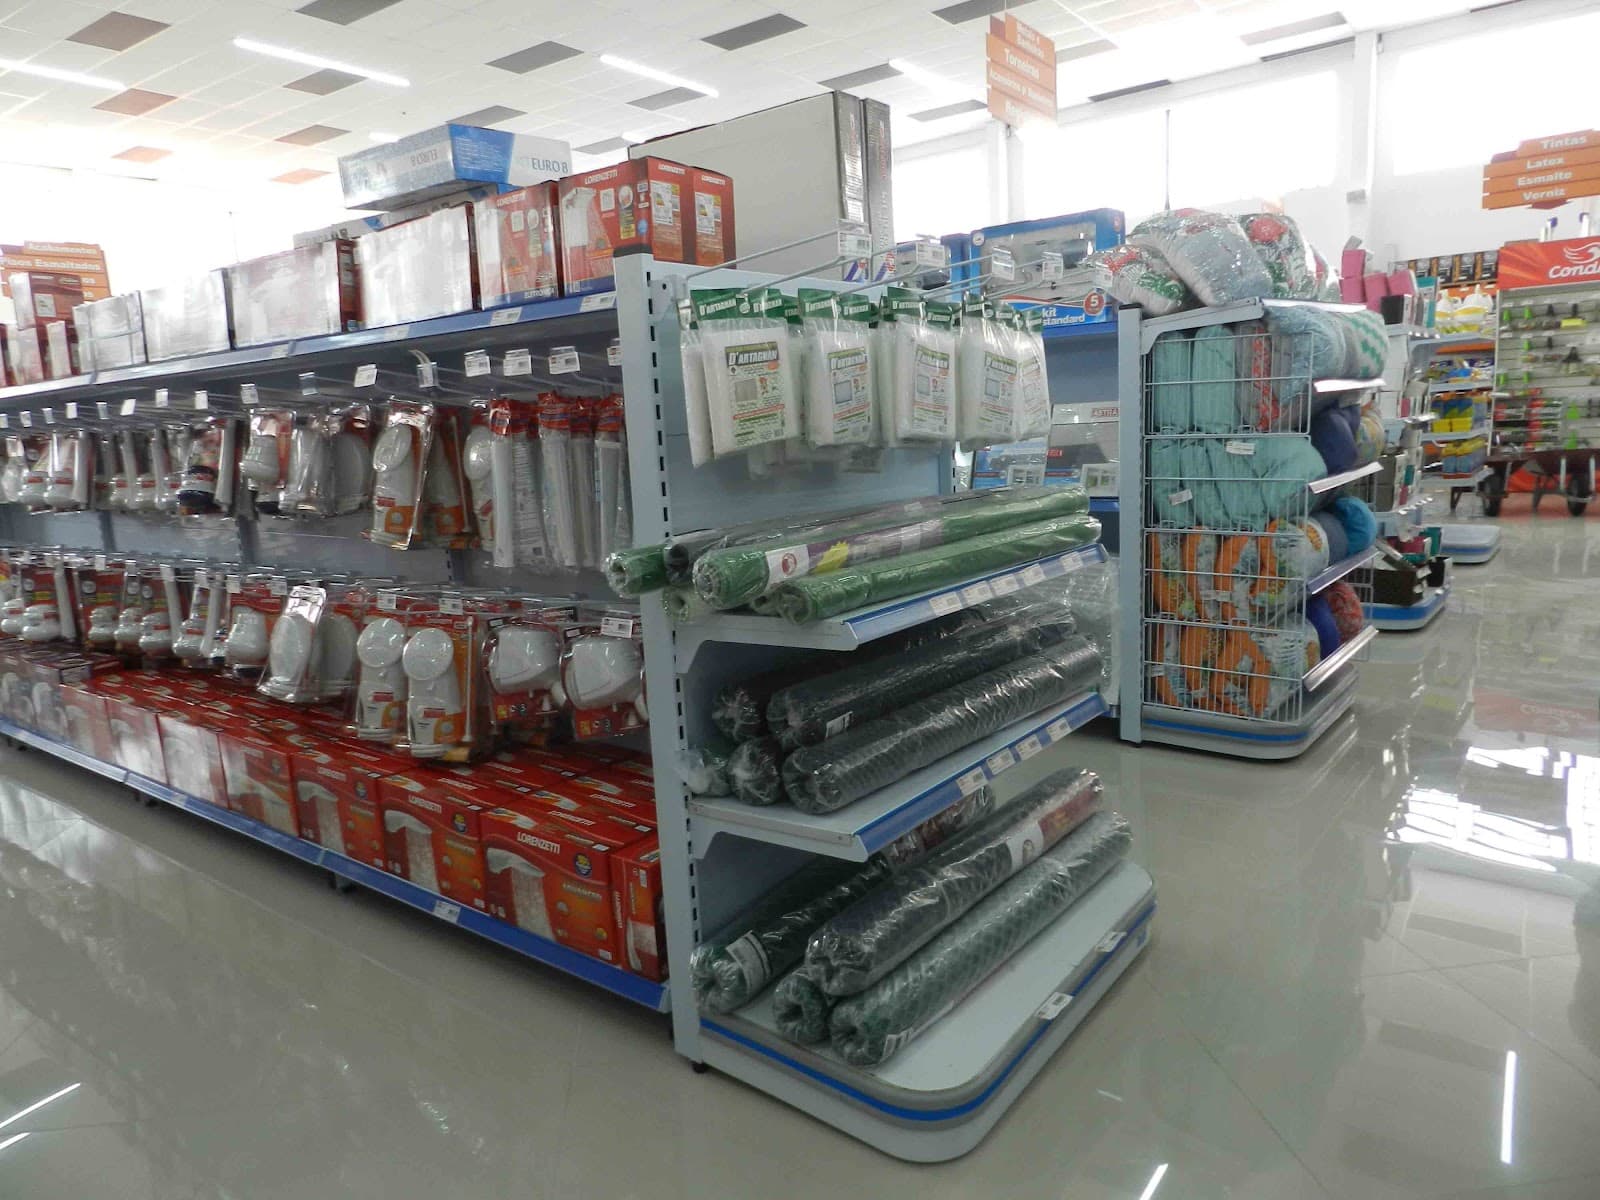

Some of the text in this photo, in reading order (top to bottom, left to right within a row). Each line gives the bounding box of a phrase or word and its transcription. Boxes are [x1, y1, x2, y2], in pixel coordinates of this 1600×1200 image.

[1542, 135, 1587, 149] Tintas
[531, 158, 569, 173] EURO 8
[1526, 156, 1564, 169] Latex
[1517, 171, 1572, 186] Esmalte
[1522, 188, 1565, 200] Verniz
[1549, 260, 1600, 279] Cond
[1042, 308, 1056, 318] kit
[1043, 313, 1085, 328] standard
[728, 351, 778, 366] D'ARTAGNAN
[516, 831, 561, 855] LORENZETTI
